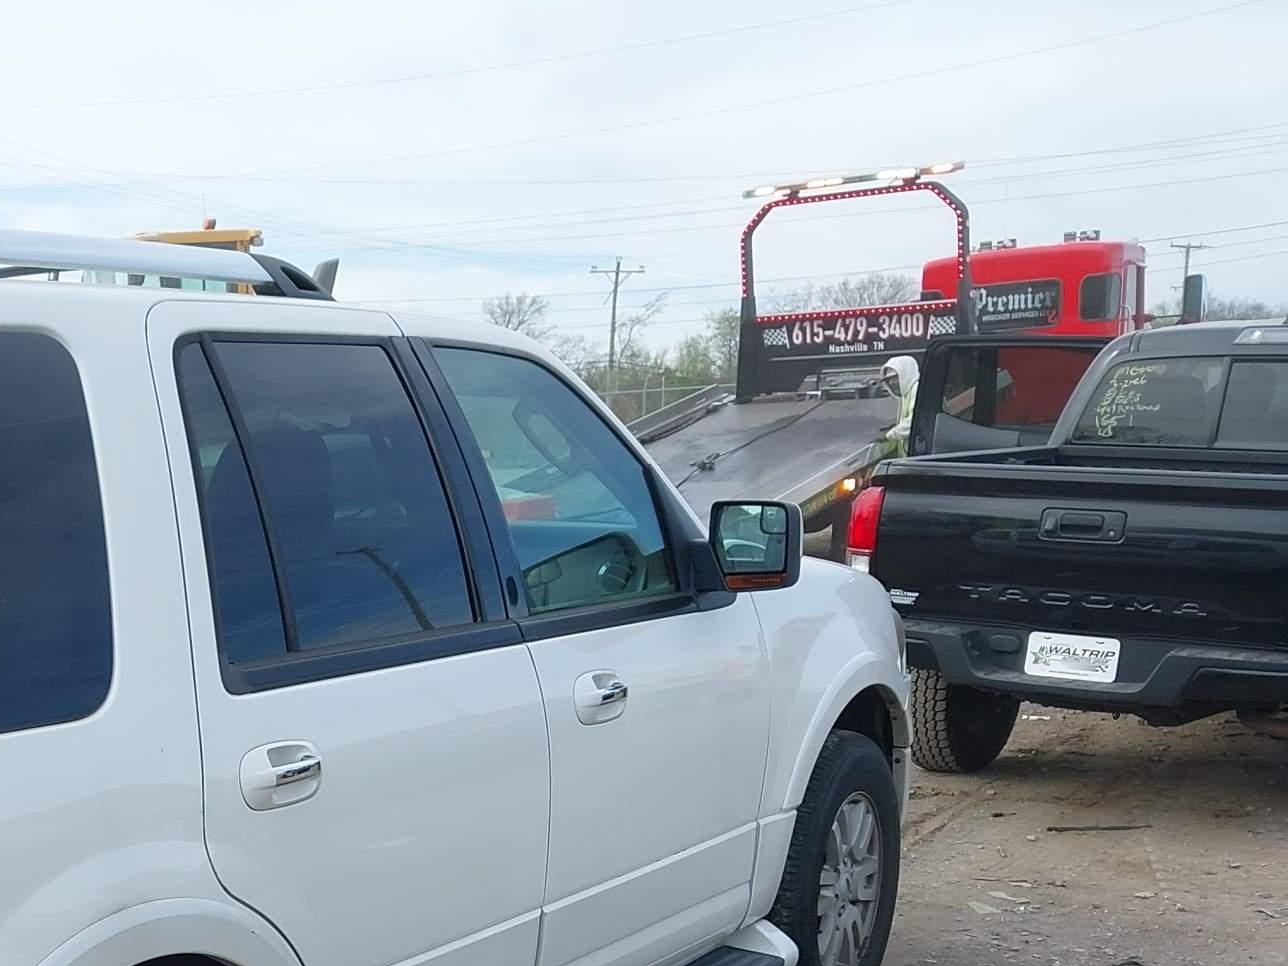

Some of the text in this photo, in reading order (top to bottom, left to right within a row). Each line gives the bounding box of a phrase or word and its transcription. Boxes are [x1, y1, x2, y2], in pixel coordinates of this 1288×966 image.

[969, 286, 1056, 317] Premier
[792, 313, 924, 345] 615-479-3400
[829, 341, 884, 353] Nashville TN
[959, 584, 1209, 617] TACOMA
[1048, 645, 1116, 659] WALTRIP
